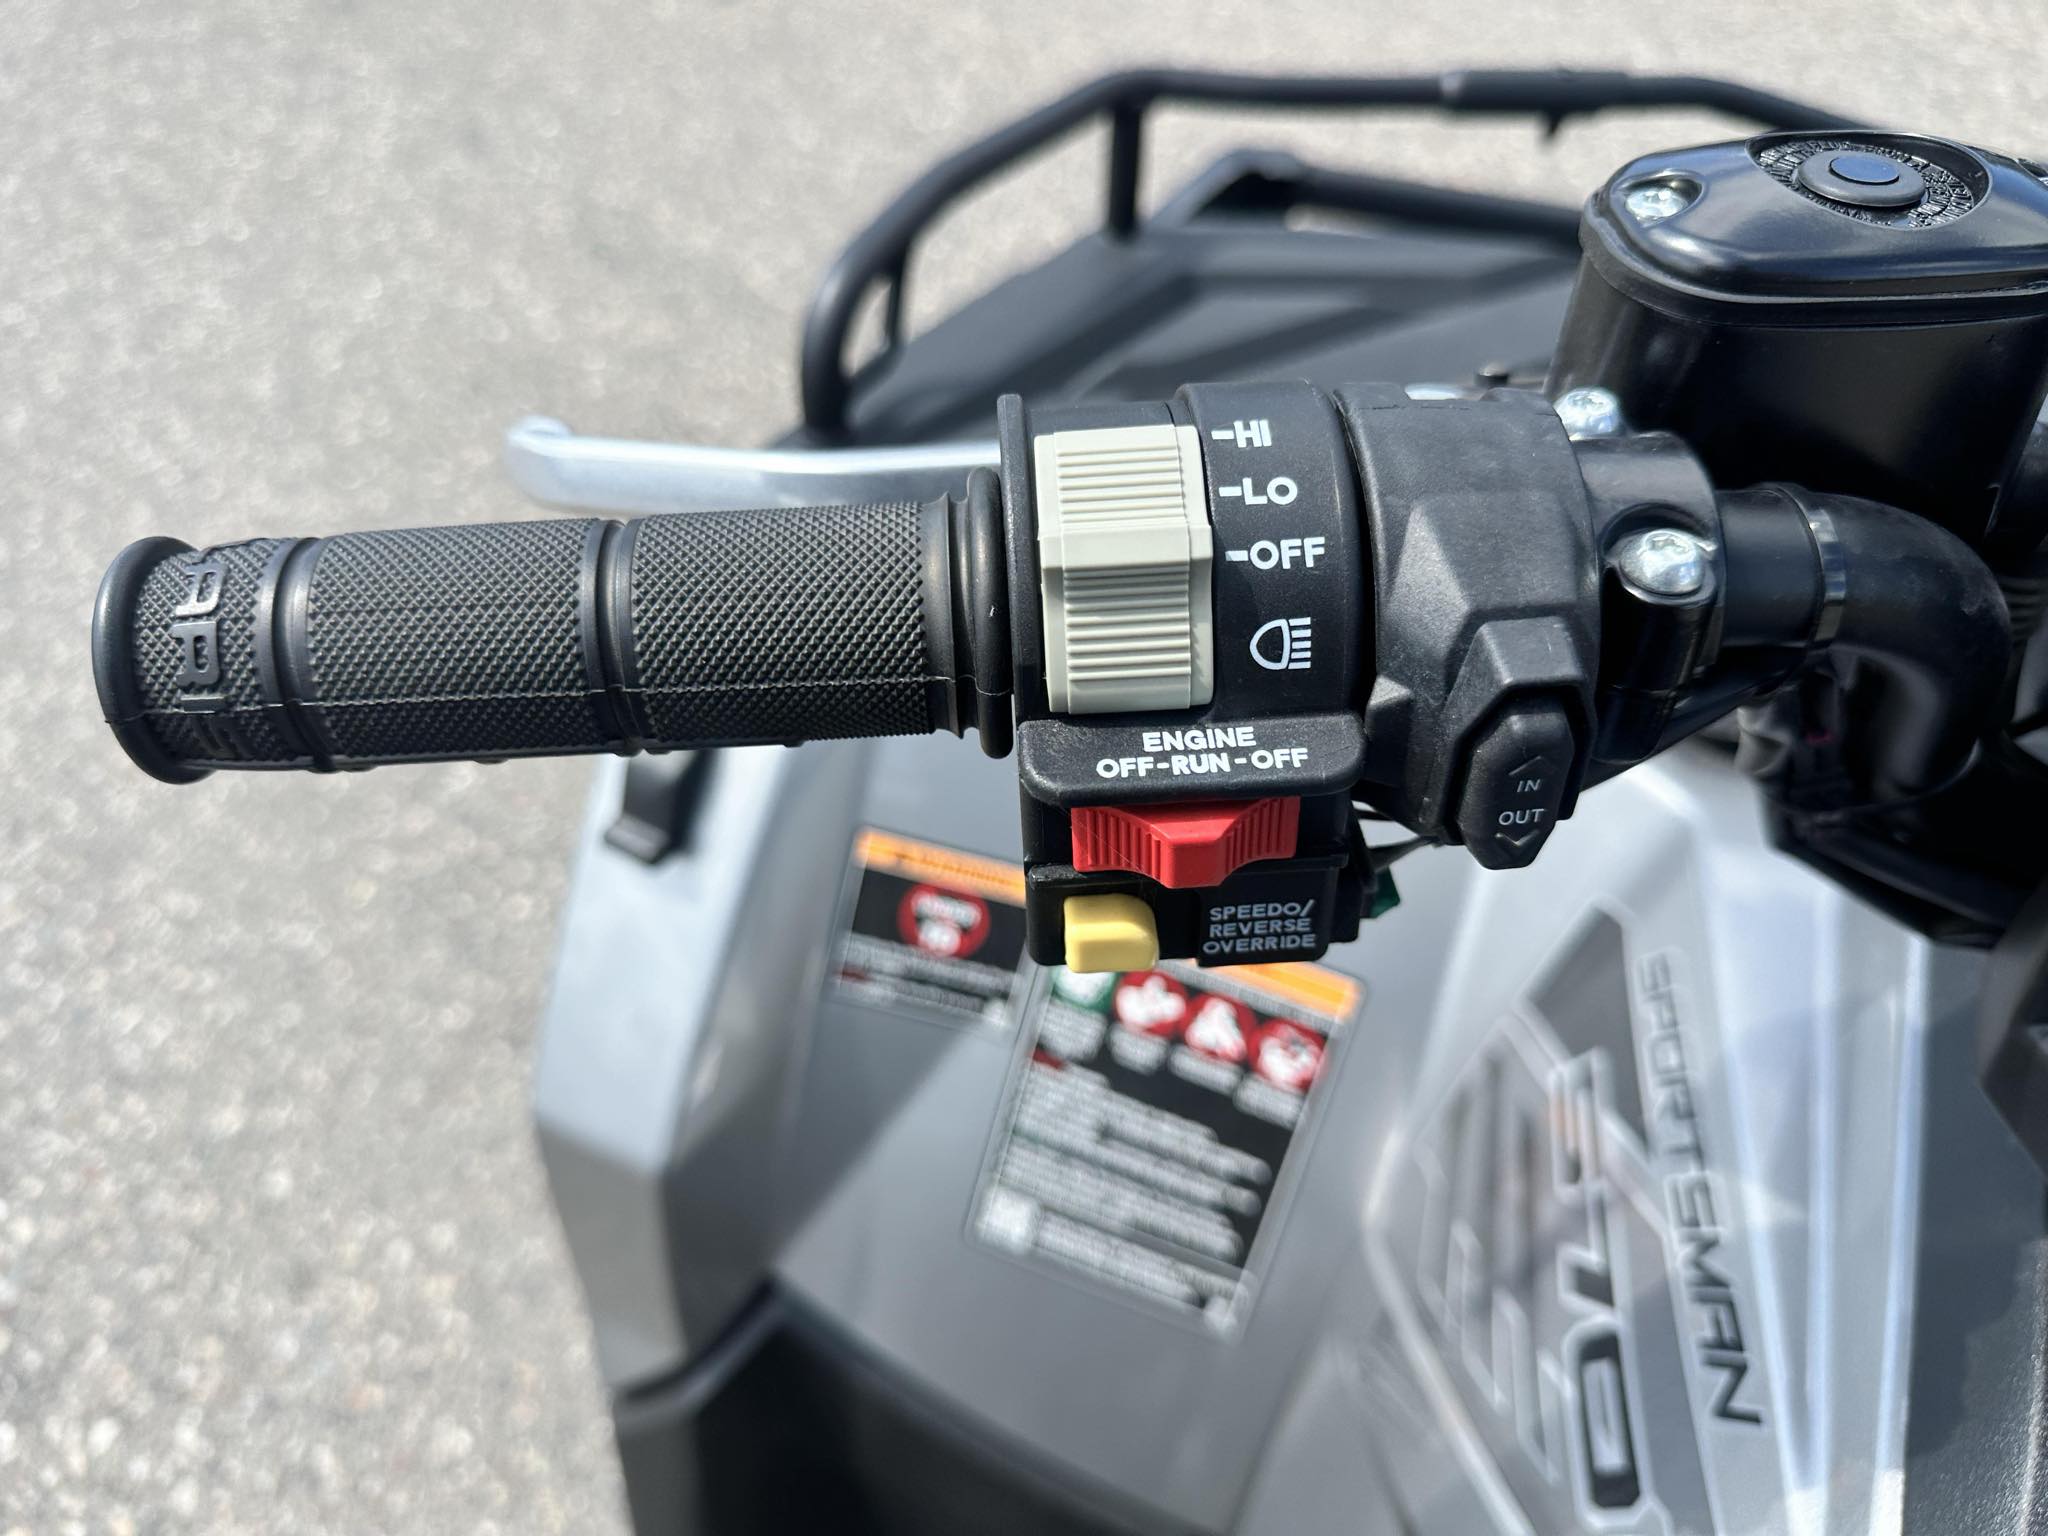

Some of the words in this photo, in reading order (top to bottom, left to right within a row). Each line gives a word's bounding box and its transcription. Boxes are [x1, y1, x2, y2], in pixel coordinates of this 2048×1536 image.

[1142, 726, 1257, 753] ENGINE
[1516, 778, 1541, 793] IN
[1498, 808, 1545, 826] OUT
[1209, 899, 1316, 922] SPEEDO/
[1209, 917, 1312, 939] REVERSE
[1202, 933, 1317, 955] OVERRIDE
[1638, 951, 1766, 1428] SPORTSMAN
